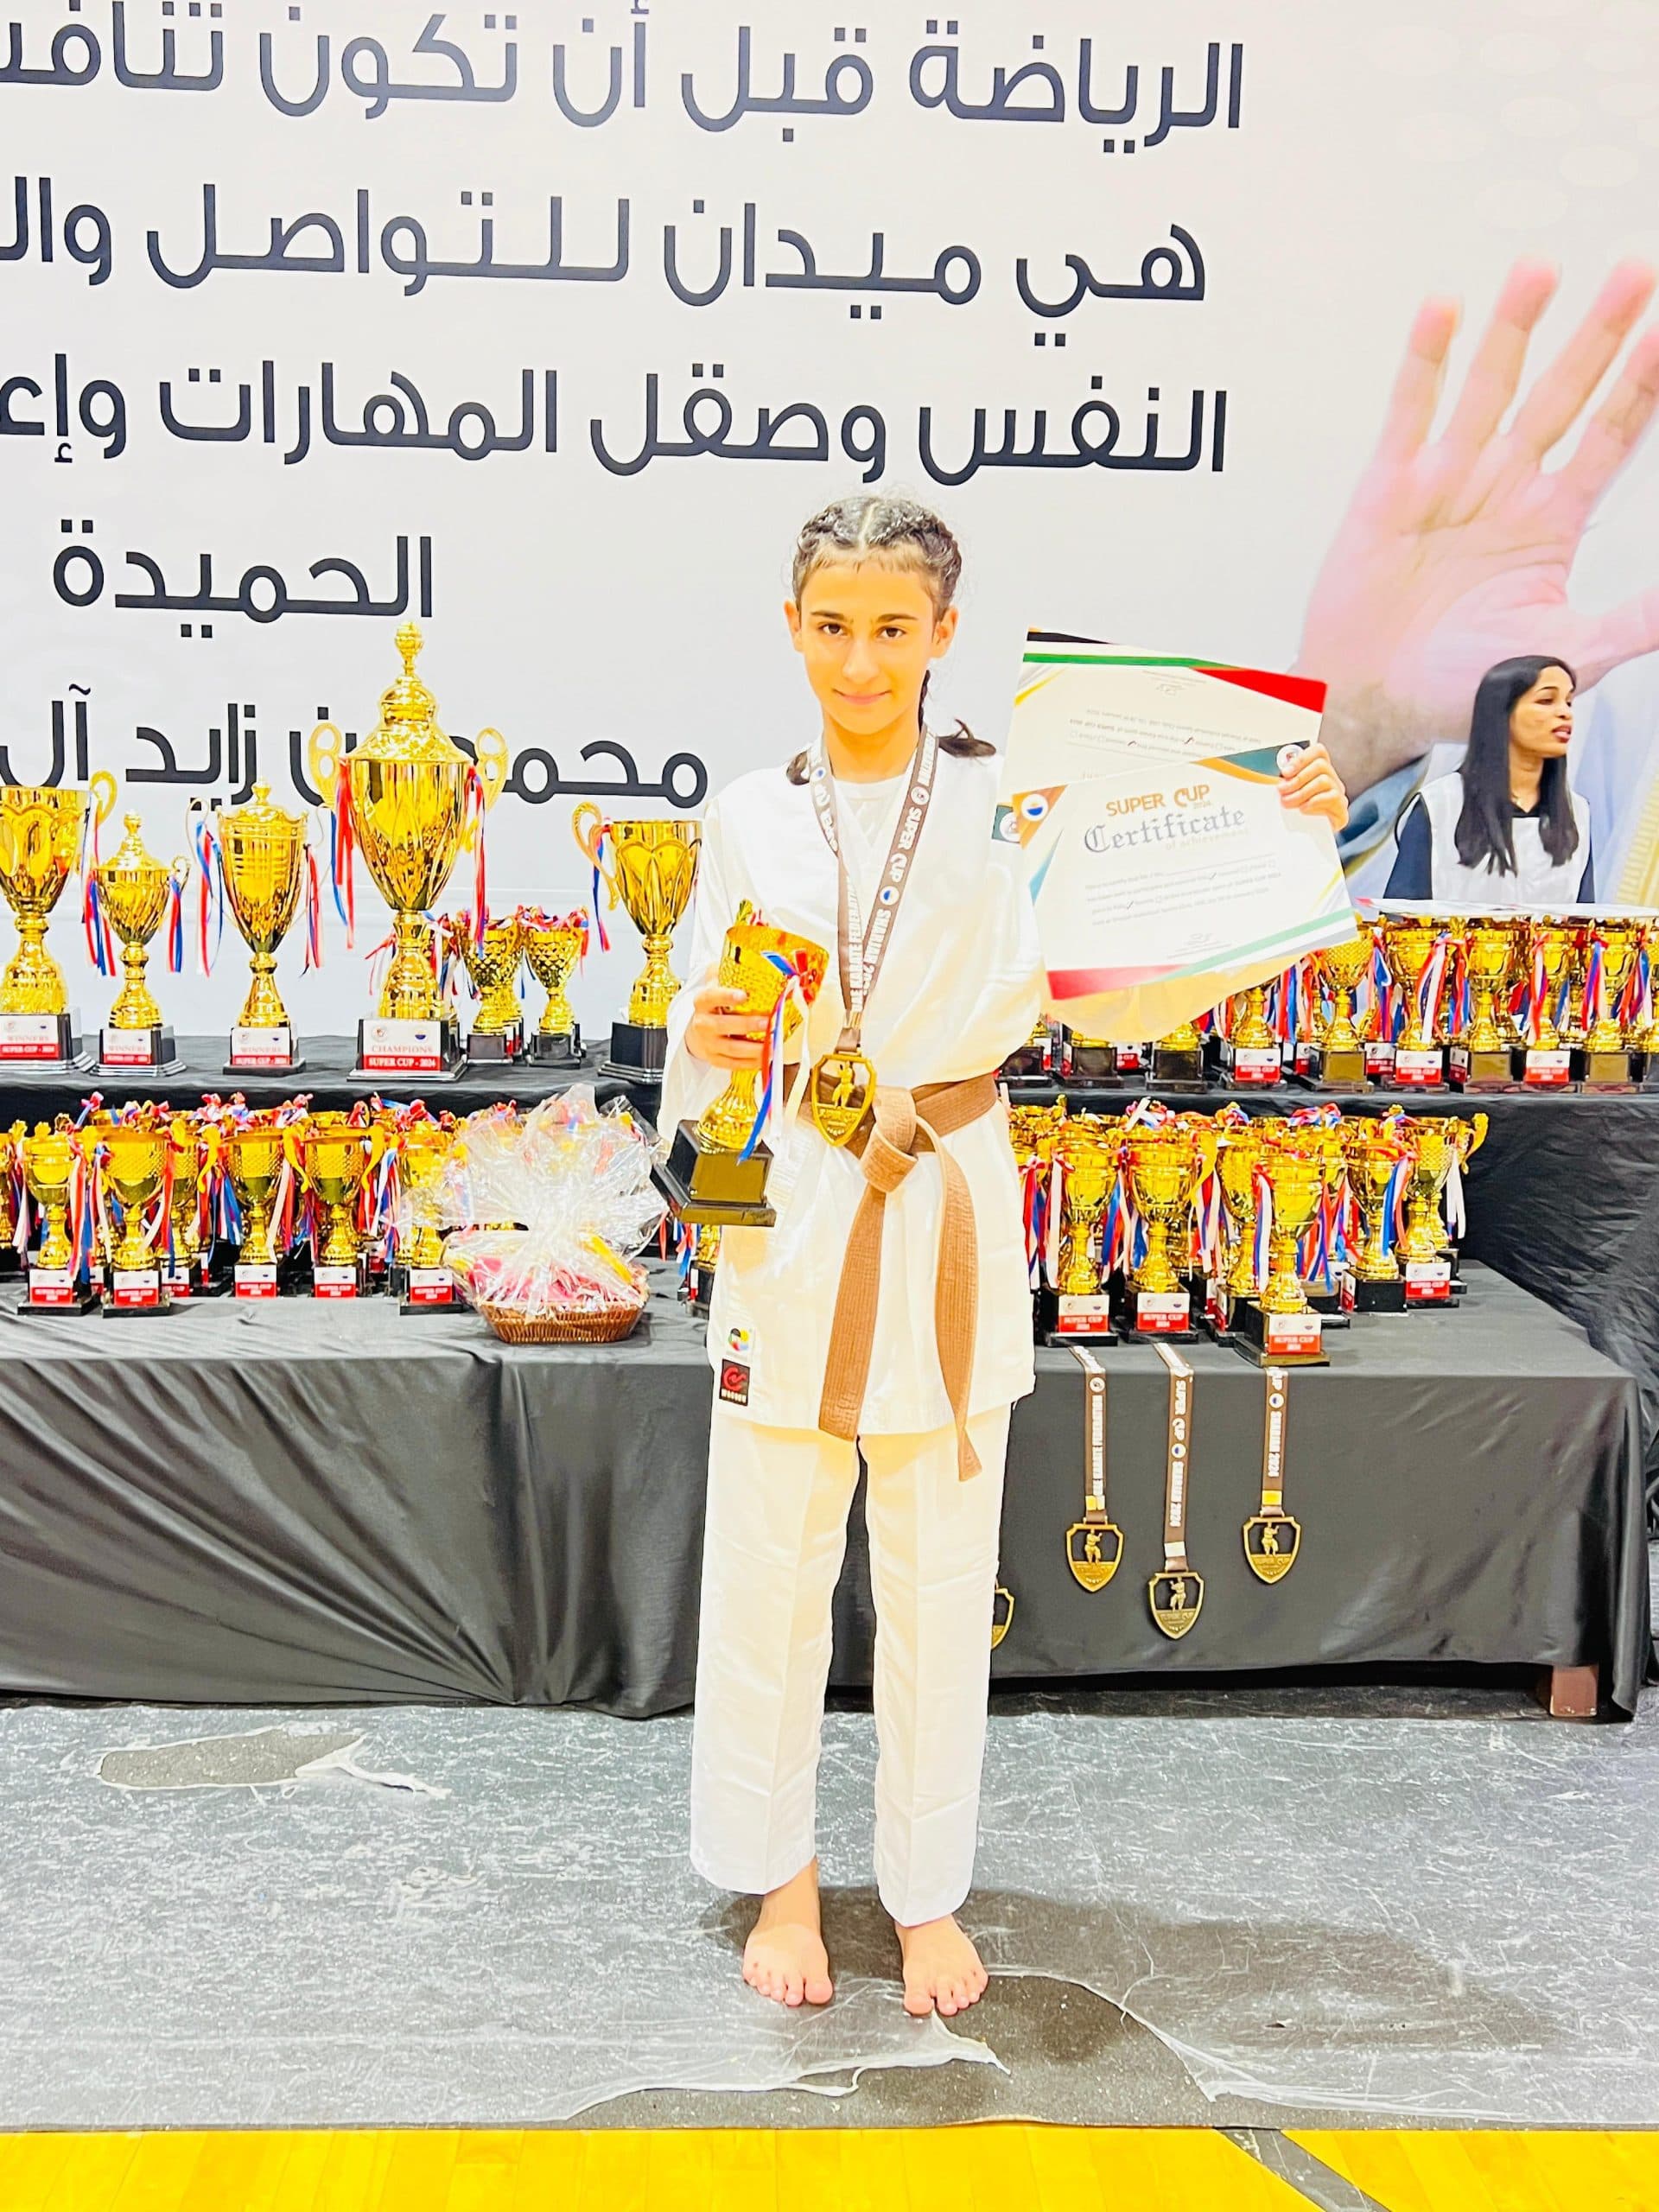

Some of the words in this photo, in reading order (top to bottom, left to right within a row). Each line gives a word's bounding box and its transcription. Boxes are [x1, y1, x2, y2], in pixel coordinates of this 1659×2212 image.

[260, 6, 517, 119] تكون
[554, 0, 649, 127] أن
[682, 27, 873, 143] قبل
[910, 21, 1243, 153] الرياضة
[147, 184, 629, 296] للتواصل
[664, 200, 981, 320] ميدان
[1017, 224, 1205, 347] هي
[160, 360, 556, 465] المهارات
[591, 363, 886, 483] وصقل
[919, 376, 1227, 486] النفس
[54, 518, 432, 639] الحميدة
[898, 805, 923, 850] SUPER
[1084, 804, 1245, 853] Certificate
[1105, 792, 1166, 817] SUPER
[1173, 784, 1211, 808] CUP
[889, 852, 908, 883] CUP
[368, 1057, 396, 1066] SUPER
[396, 1057, 415, 1067] CUP
[372, 1044, 433, 1053] CHAMPIONS
